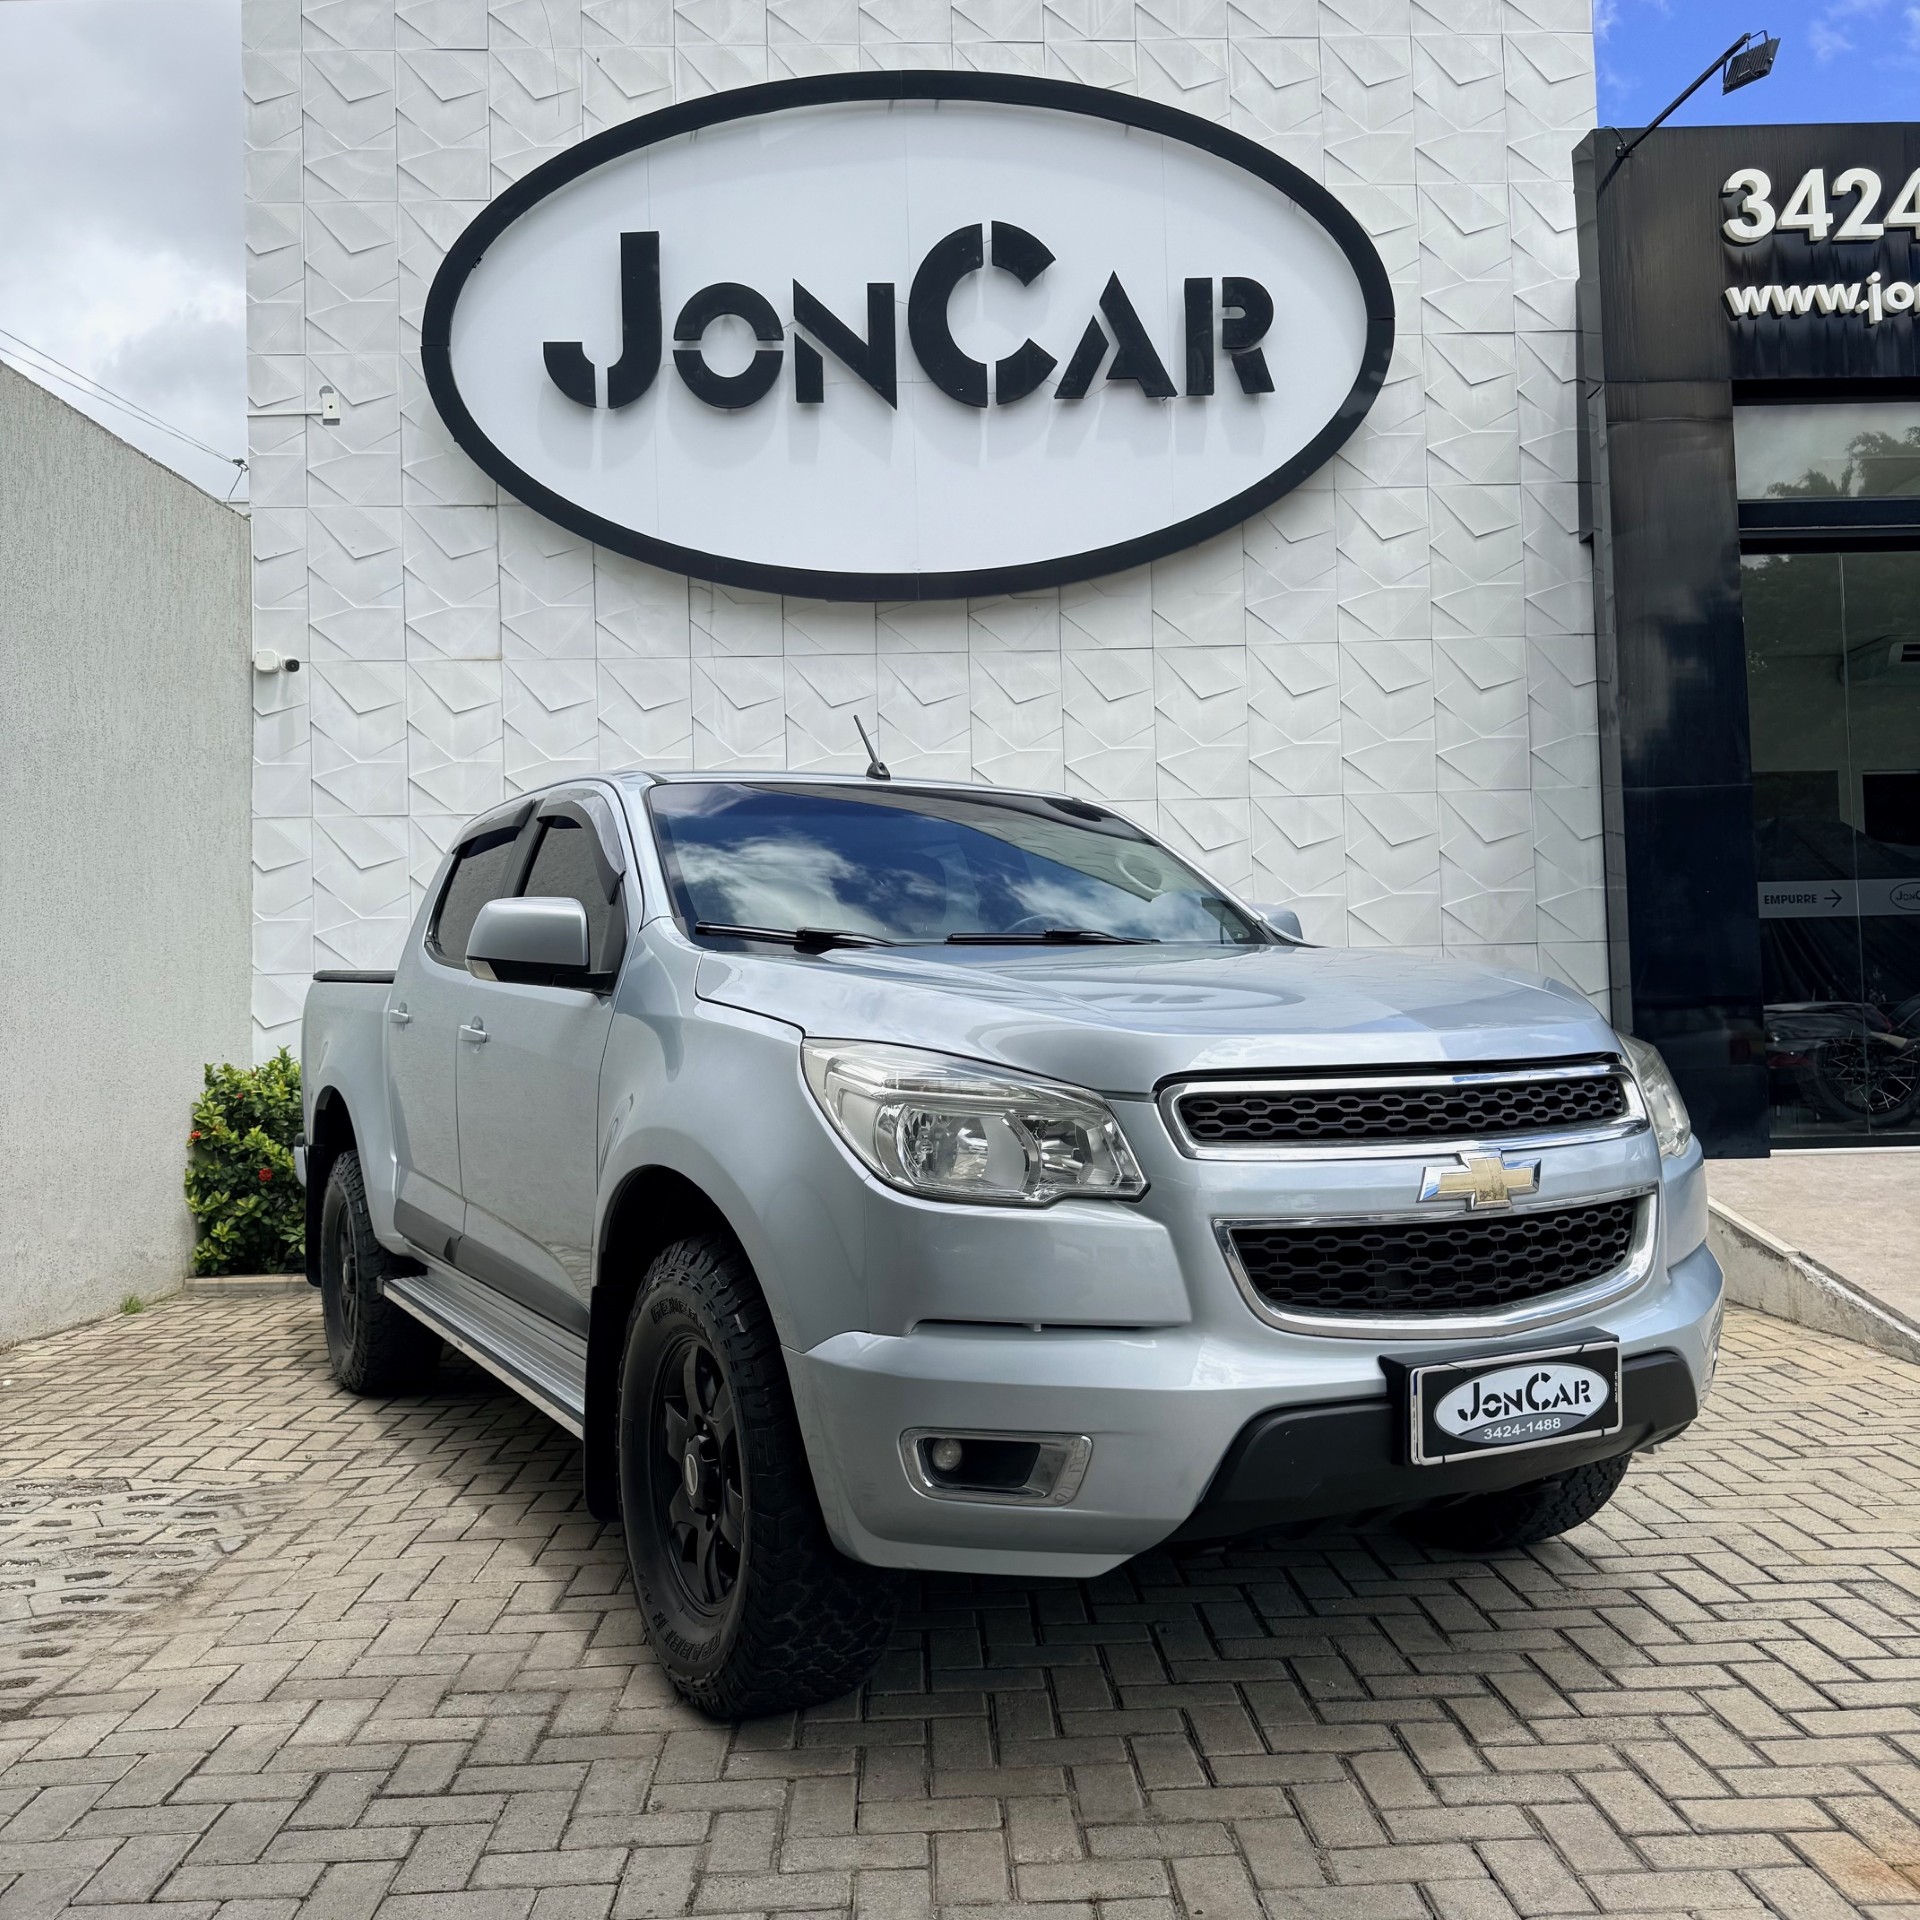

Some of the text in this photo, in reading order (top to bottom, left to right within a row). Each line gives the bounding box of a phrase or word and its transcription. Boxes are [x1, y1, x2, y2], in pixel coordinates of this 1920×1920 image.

[1722, 168, 1920, 243] 3424
[1725, 271, 1920, 324] www.jo
[1764, 894, 1818, 905] EMPURRE
[1483, 1417, 1562, 1440] 3424-1488
